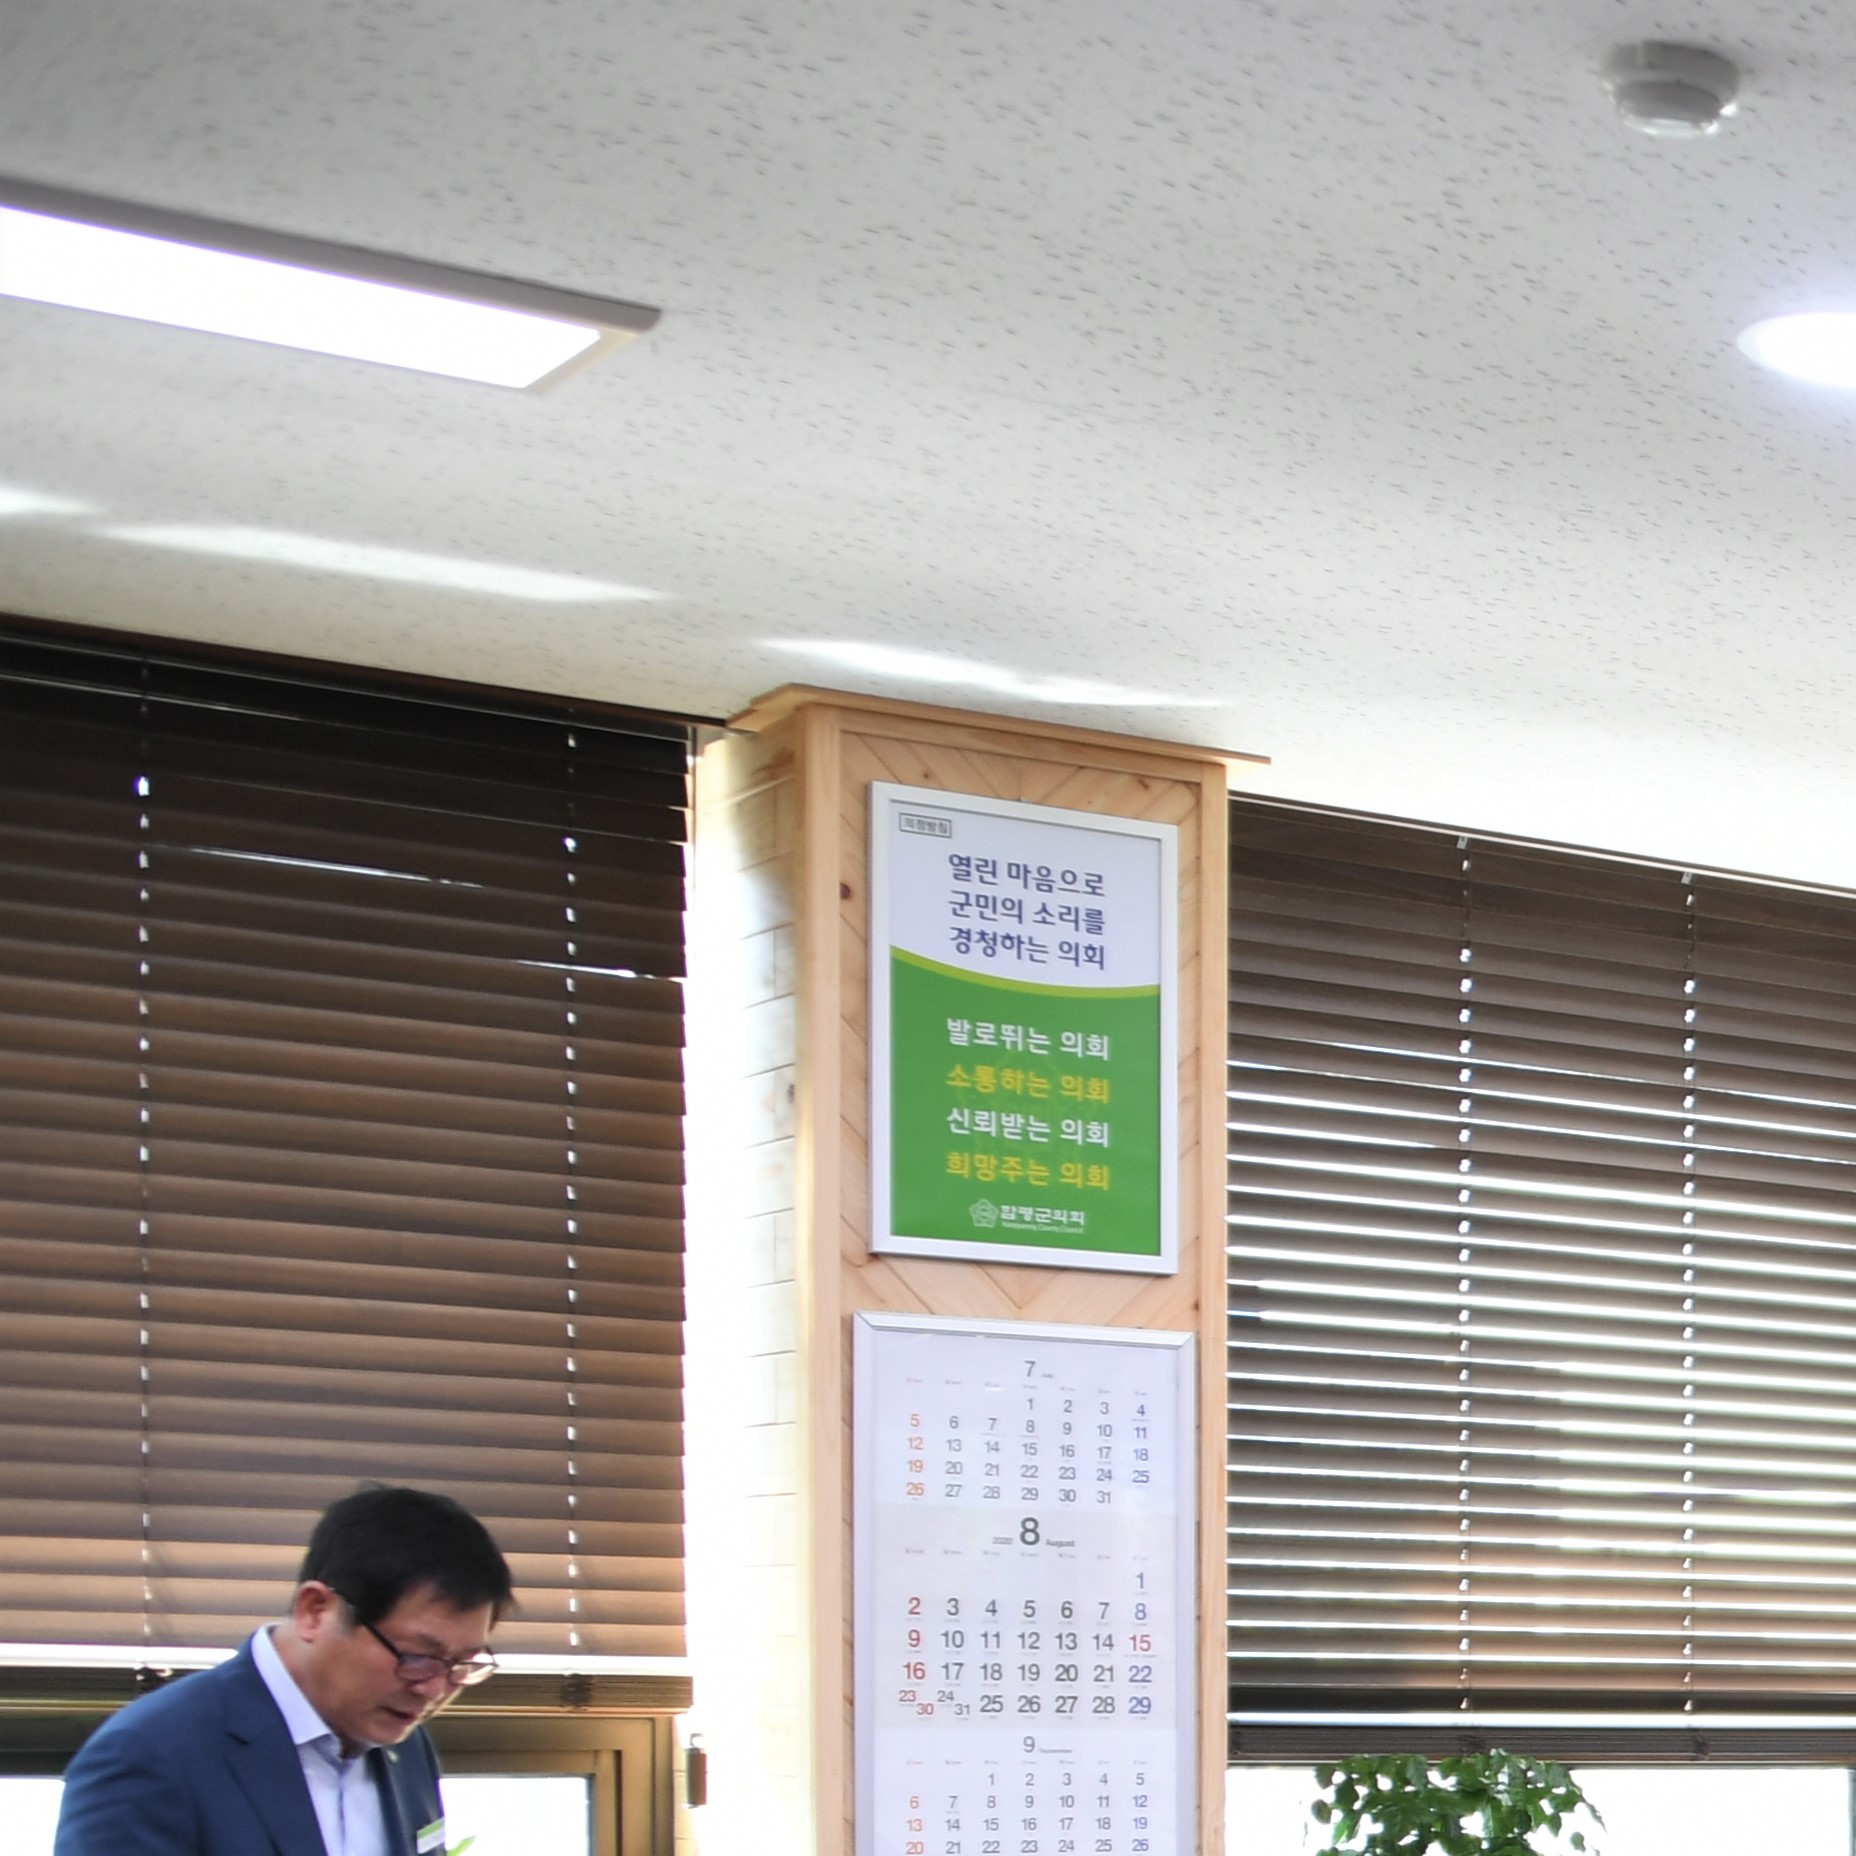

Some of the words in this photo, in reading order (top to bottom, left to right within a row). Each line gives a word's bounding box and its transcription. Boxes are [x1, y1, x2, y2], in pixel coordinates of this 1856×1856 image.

[948, 853, 998, 886] 열린
[1007, 862, 1105, 897] 마음으로
[948, 890, 1023, 925] 군민의
[1032, 902, 1105, 935] 소리를
[949, 926, 1049, 964] 경청하는
[1057, 940, 1104, 970] 의회
[947, 1018, 1051, 1055] 발로뛰는
[1060, 1031, 1108, 1061] 의회
[946, 1063, 1051, 1098] 소통하는
[1060, 1075, 1108, 1104] 의회
[947, 1107, 1051, 1143] 신뢰받는
[1060, 1119, 1108, 1148] 의회
[946, 1151, 1051, 1186] 희망주는
[1060, 1162, 1108, 1191] 의회
[1024, 1360, 1036, 1377] 7
[1026, 1397, 1034, 1411] 1
[1063, 1399, 1073, 1414] 2
[1099, 1401, 1110, 1416] 3
[1136, 1404, 1146, 1417] 4
[909, 1413, 921, 1428] 5
[948, 1415, 960, 1430] 6
[987, 1417, 998, 1431] 7
[1025, 1419, 1036, 1434] 8
[1062, 1421, 1073, 1436] 9
[1096, 1423, 1113, 1438] 10
[1134, 1426, 1147, 1439] 11
[907, 1436, 924, 1451] 12
[945, 1438, 963, 1453] 13
[984, 1440, 1001, 1454] 14
[1021, 1441, 1038, 1457] 15
[1058, 1444, 1076, 1458] 16
[1097, 1445, 1113, 1460] 17
[1133, 1447, 1149, 1462] 18
[907, 1458, 924, 1474] 19
[944, 1460, 964, 1476] 20
[984, 1462, 1000, 1477] 21
[1020, 1464, 1039, 1479] 22
[1058, 1465, 1077, 1481] 23
[1096, 1467, 1113, 1482] 24
[1131, 1469, 1150, 1484] 25
[906, 1481, 925, 1497] 26
[944, 1483, 963, 1498] 27
[982, 1485, 1001, 1500] 28
[1021, 1486, 1039, 1501] 29
[1058, 1488, 1077, 1503] 30
[1096, 1490, 1112, 1504] 31
[1019, 1516, 1040, 1546] 8
[1135, 1571, 1144, 1590] 1
[908, 1596, 921, 1616] 2
[946, 1597, 960, 1617] 3
[984, 1599, 998, 1617] 4
[1023, 1599, 1036, 1619] 5
[1060, 1600, 1074, 1620] 6
[1098, 1601, 1110, 1620] 7
[1134, 1602, 1148, 1621] 8
[907, 1629, 921, 1648] 9
[940, 1629, 965, 1649] 10
[980, 1631, 1001, 1649] 11
[1017, 1631, 1041, 1650] 12
[1055, 1632, 1078, 1651] 13
[1092, 1633, 1115, 1651] 14
[1128, 1634, 1152, 1652] 15
[902, 1661, 926, 1681] 16
[941, 1662, 965, 1681] 17
[979, 1662, 1003, 1682] 18
[1017, 1663, 1041, 1682] 19
[1054, 1663, 1079, 1683] 20
[1093, 1664, 1114, 1683] 21
[1128, 1664, 1153, 1684] 22
[898, 1689, 917, 1703] 23
[936, 1689, 955, 1703] 24
[979, 1694, 1004, 1713] 25
[1017, 1694, 1041, 1714] 26
[1054, 1695, 1079, 1714] 27
[1091, 1695, 1116, 1714] 28
[1127, 1695, 1152, 1715] 29
[915, 1702, 935, 1716] 30
[954, 1702, 971, 1716] 31
[1023, 1735, 1036, 1753] 9
[987, 1773, 995, 1786] 1
[1025, 1772, 1035, 1787] 2
[1062, 1772, 1072, 1787] 3
[1099, 1773, 1109, 1785] 4
[1135, 1772, 1145, 1786] 5
[909, 1795, 920, 1810] 6
[948, 1795, 959, 1809] 7
[986, 1794, 997, 1809] 8
[1024, 1794, 1035, 1809] 9
[1058, 1794, 1075, 1809] 10
[1096, 1795, 1110, 1808] 11
[1132, 1794, 1148, 1808] 12
[906, 1817, 924, 1833] 13
[945, 1818, 961, 1831] 14
[983, 1817, 1000, 1832] 15
[1021, 1817, 1038, 1831] 16
[1058, 1816, 1074, 1831] 17
[1095, 1816, 1112, 1831] 18
[1132, 1816, 1148, 1830] 19
[905, 1840, 925, 1856] 20
[945, 1840, 961, 1855] 21
[981, 1840, 1001, 1854] 22
[1020, 1839, 1039, 1854] 23
[1057, 1839, 1075, 1853] 24
[1095, 1838, 1113, 1853] 25
[1131, 1838, 1150, 1852] 26
